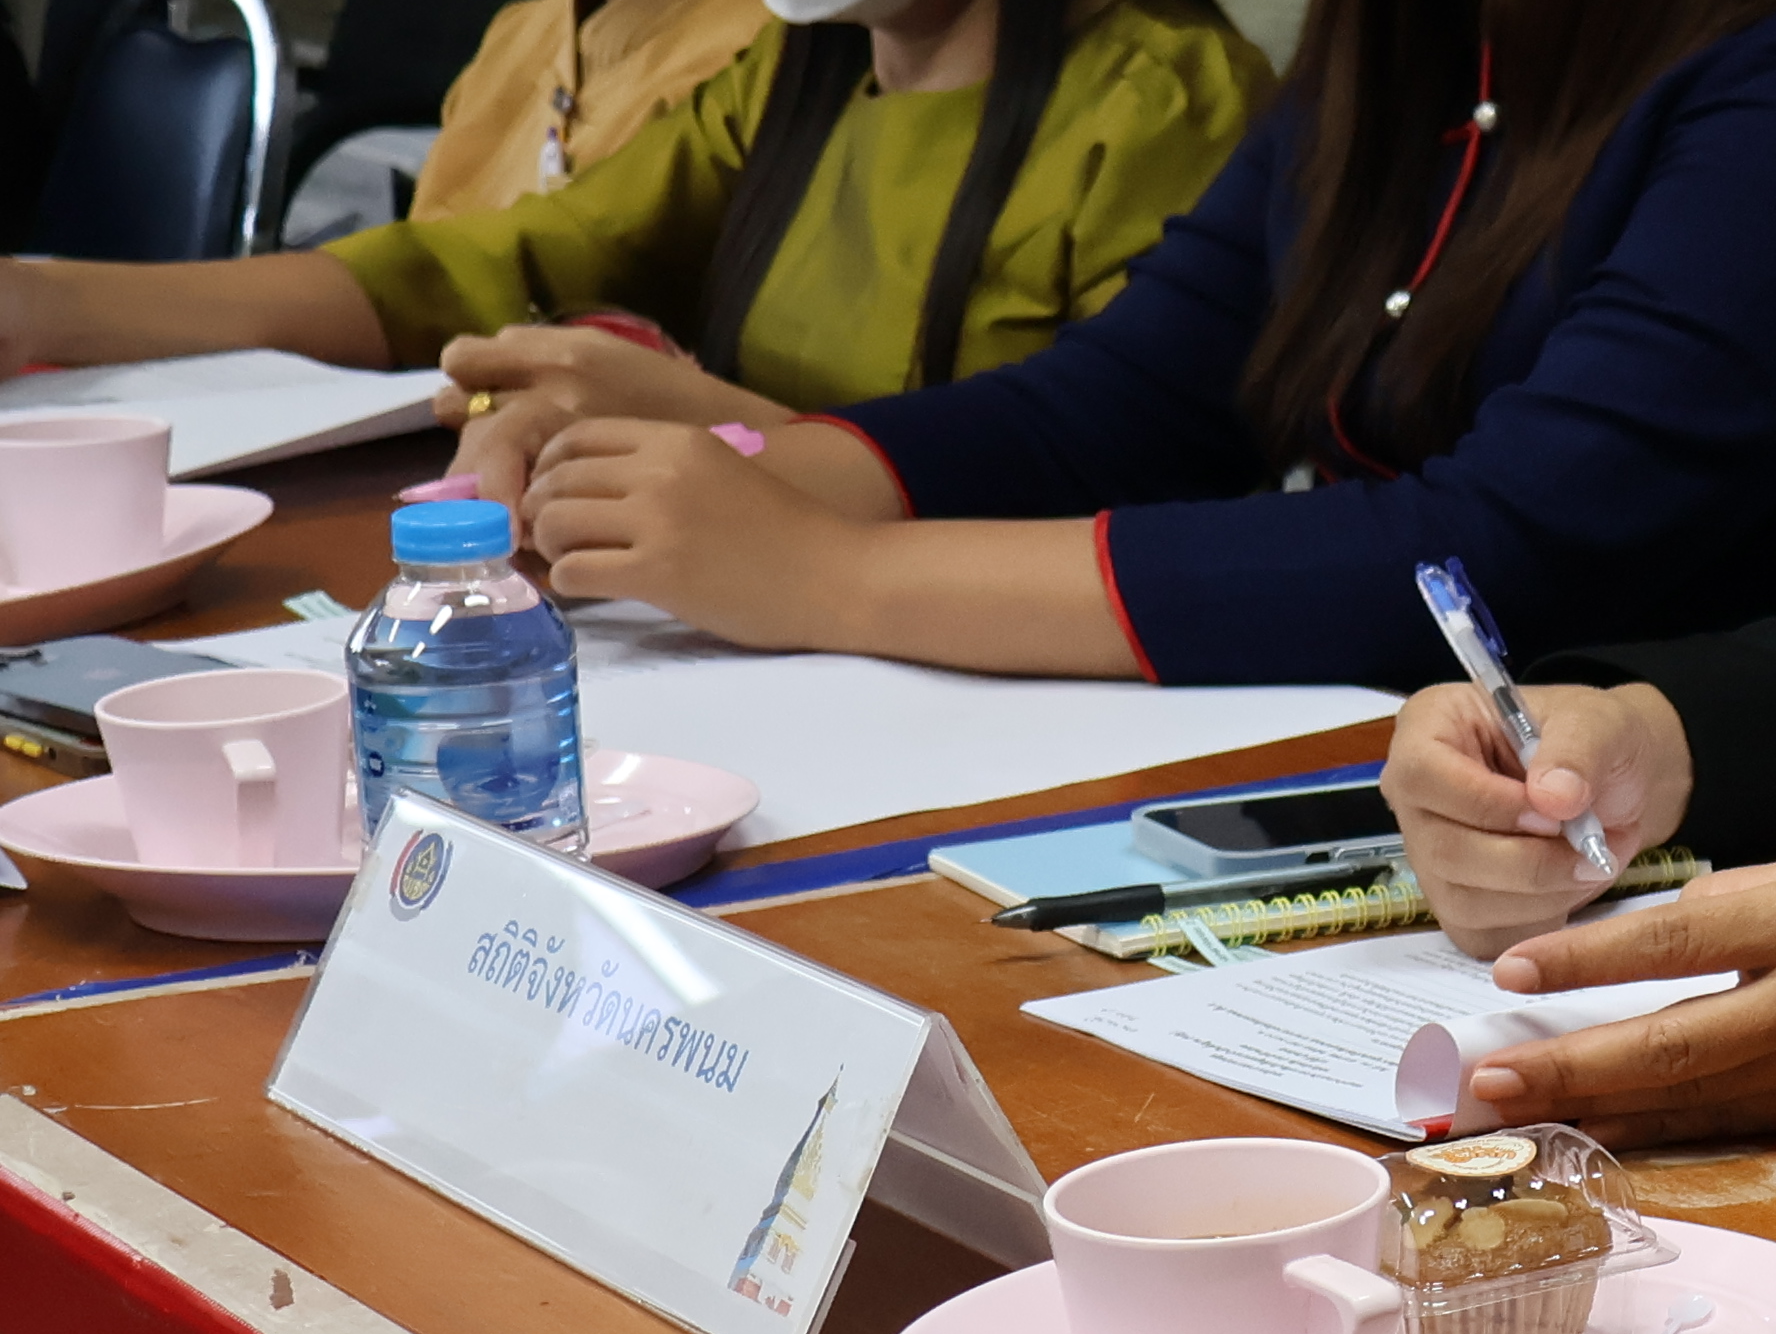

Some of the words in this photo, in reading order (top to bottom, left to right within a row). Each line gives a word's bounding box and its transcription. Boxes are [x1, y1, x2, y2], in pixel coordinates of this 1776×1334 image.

[467, 918, 749, 1094] สถิติจังหวัดนครพนม
